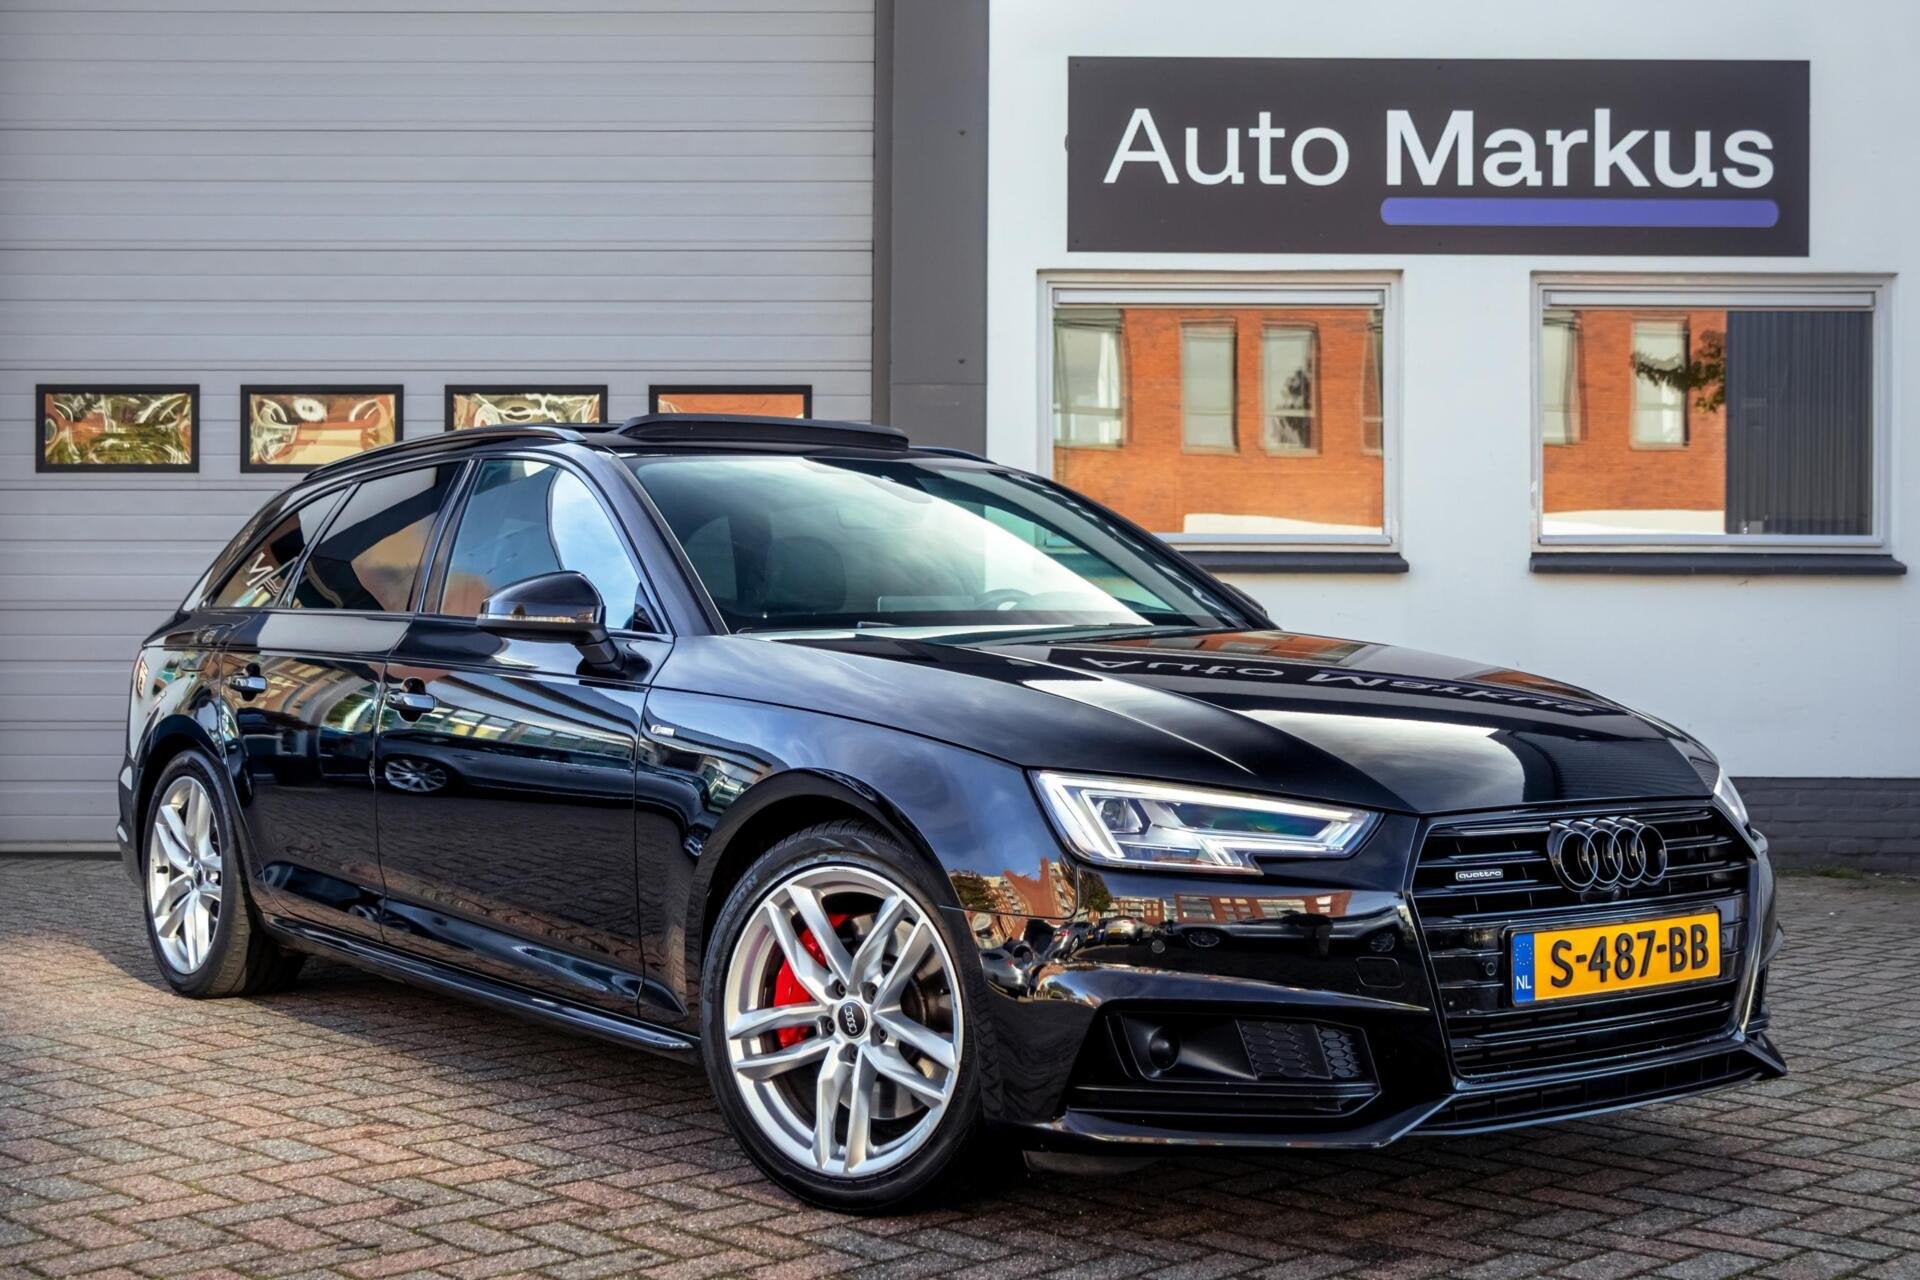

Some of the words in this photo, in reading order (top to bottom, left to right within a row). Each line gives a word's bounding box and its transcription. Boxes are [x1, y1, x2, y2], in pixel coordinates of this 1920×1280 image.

[1104, 107, 1349, 186] Auto
[1386, 107, 1775, 188] Markus
[1458, 870, 1502, 880] quattro
[1551, 924, 1709, 988] S-487-BB
[1516, 976, 1532, 989] NL
